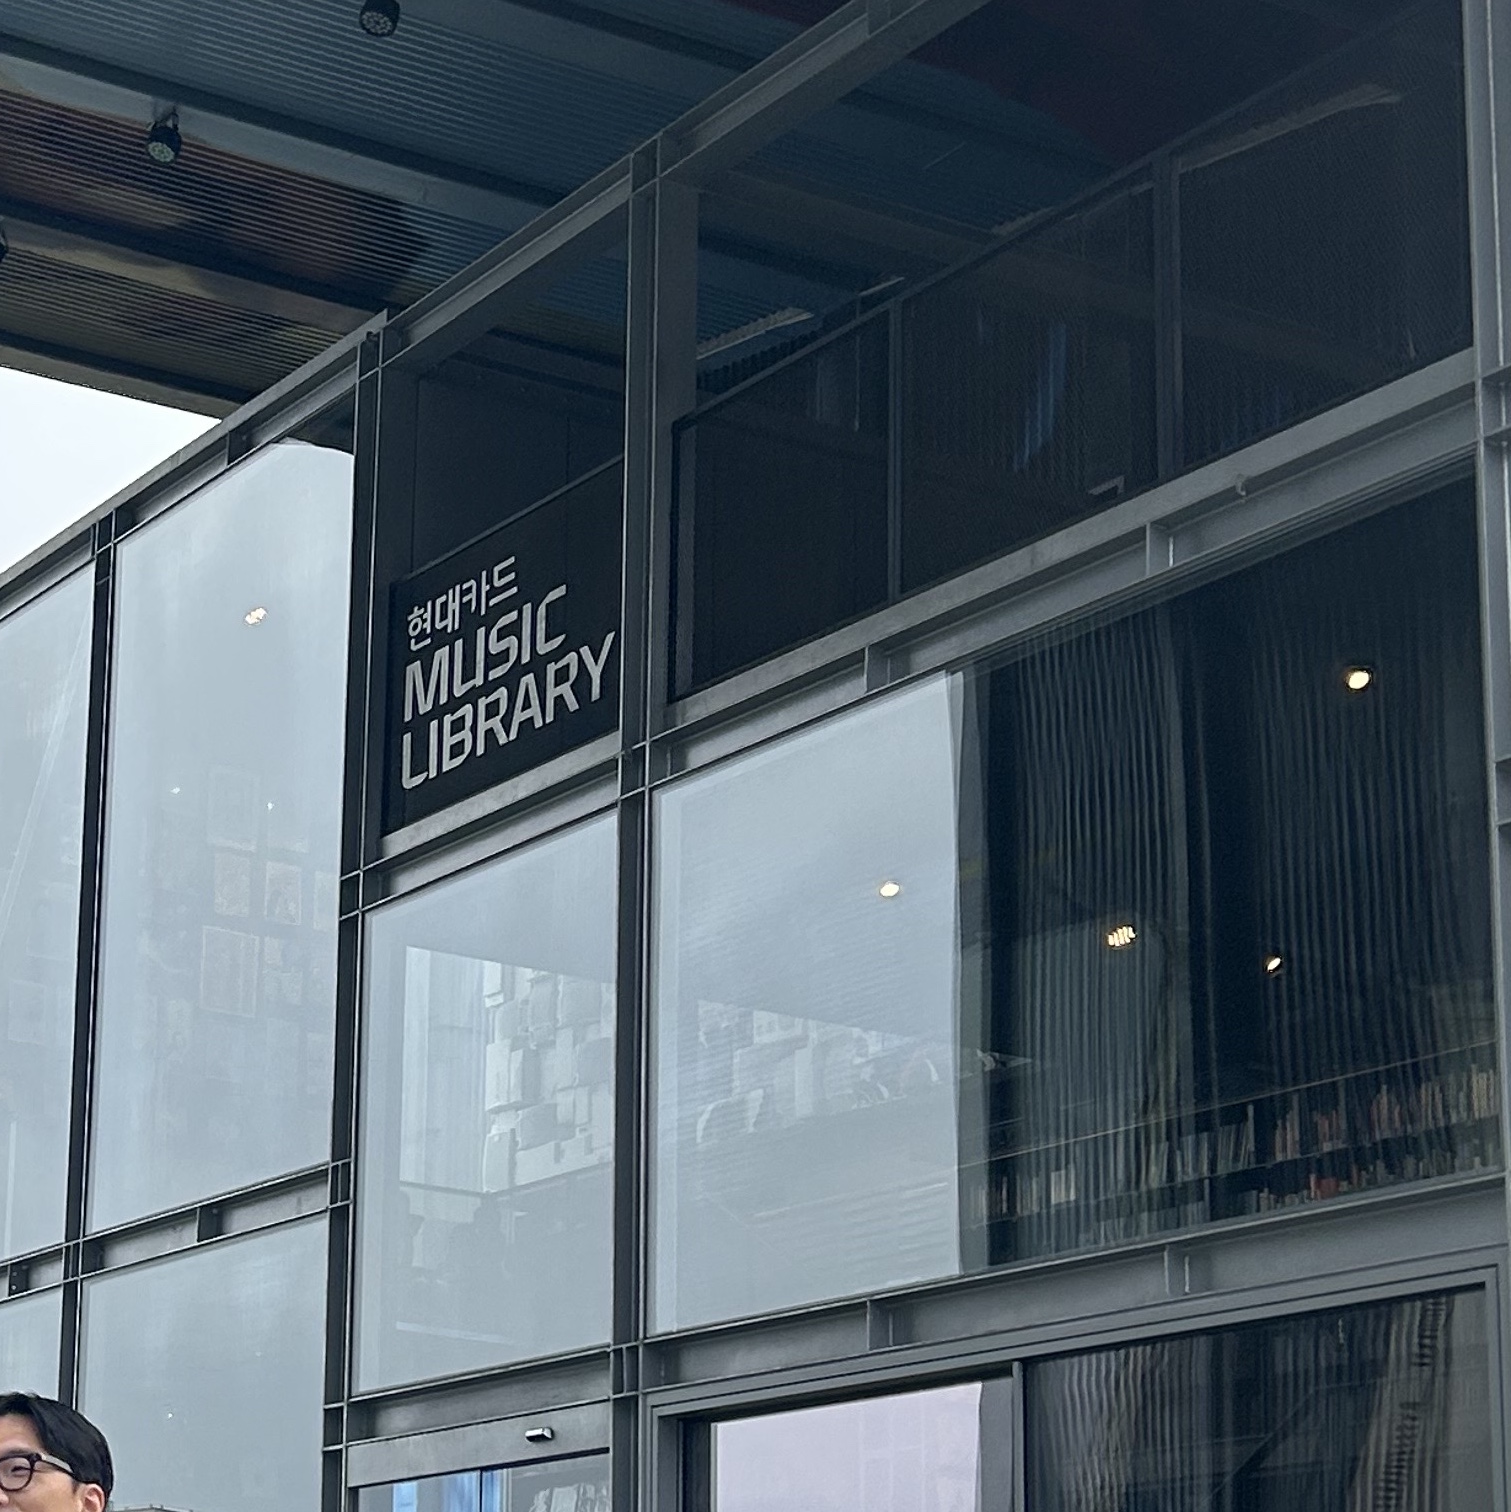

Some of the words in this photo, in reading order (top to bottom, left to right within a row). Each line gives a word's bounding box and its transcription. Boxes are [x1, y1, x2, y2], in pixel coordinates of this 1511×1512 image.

[403, 584, 567, 722] MUSIC
[406, 556, 519, 651] 현대카드
[402, 631, 616, 790] LIBRARY
